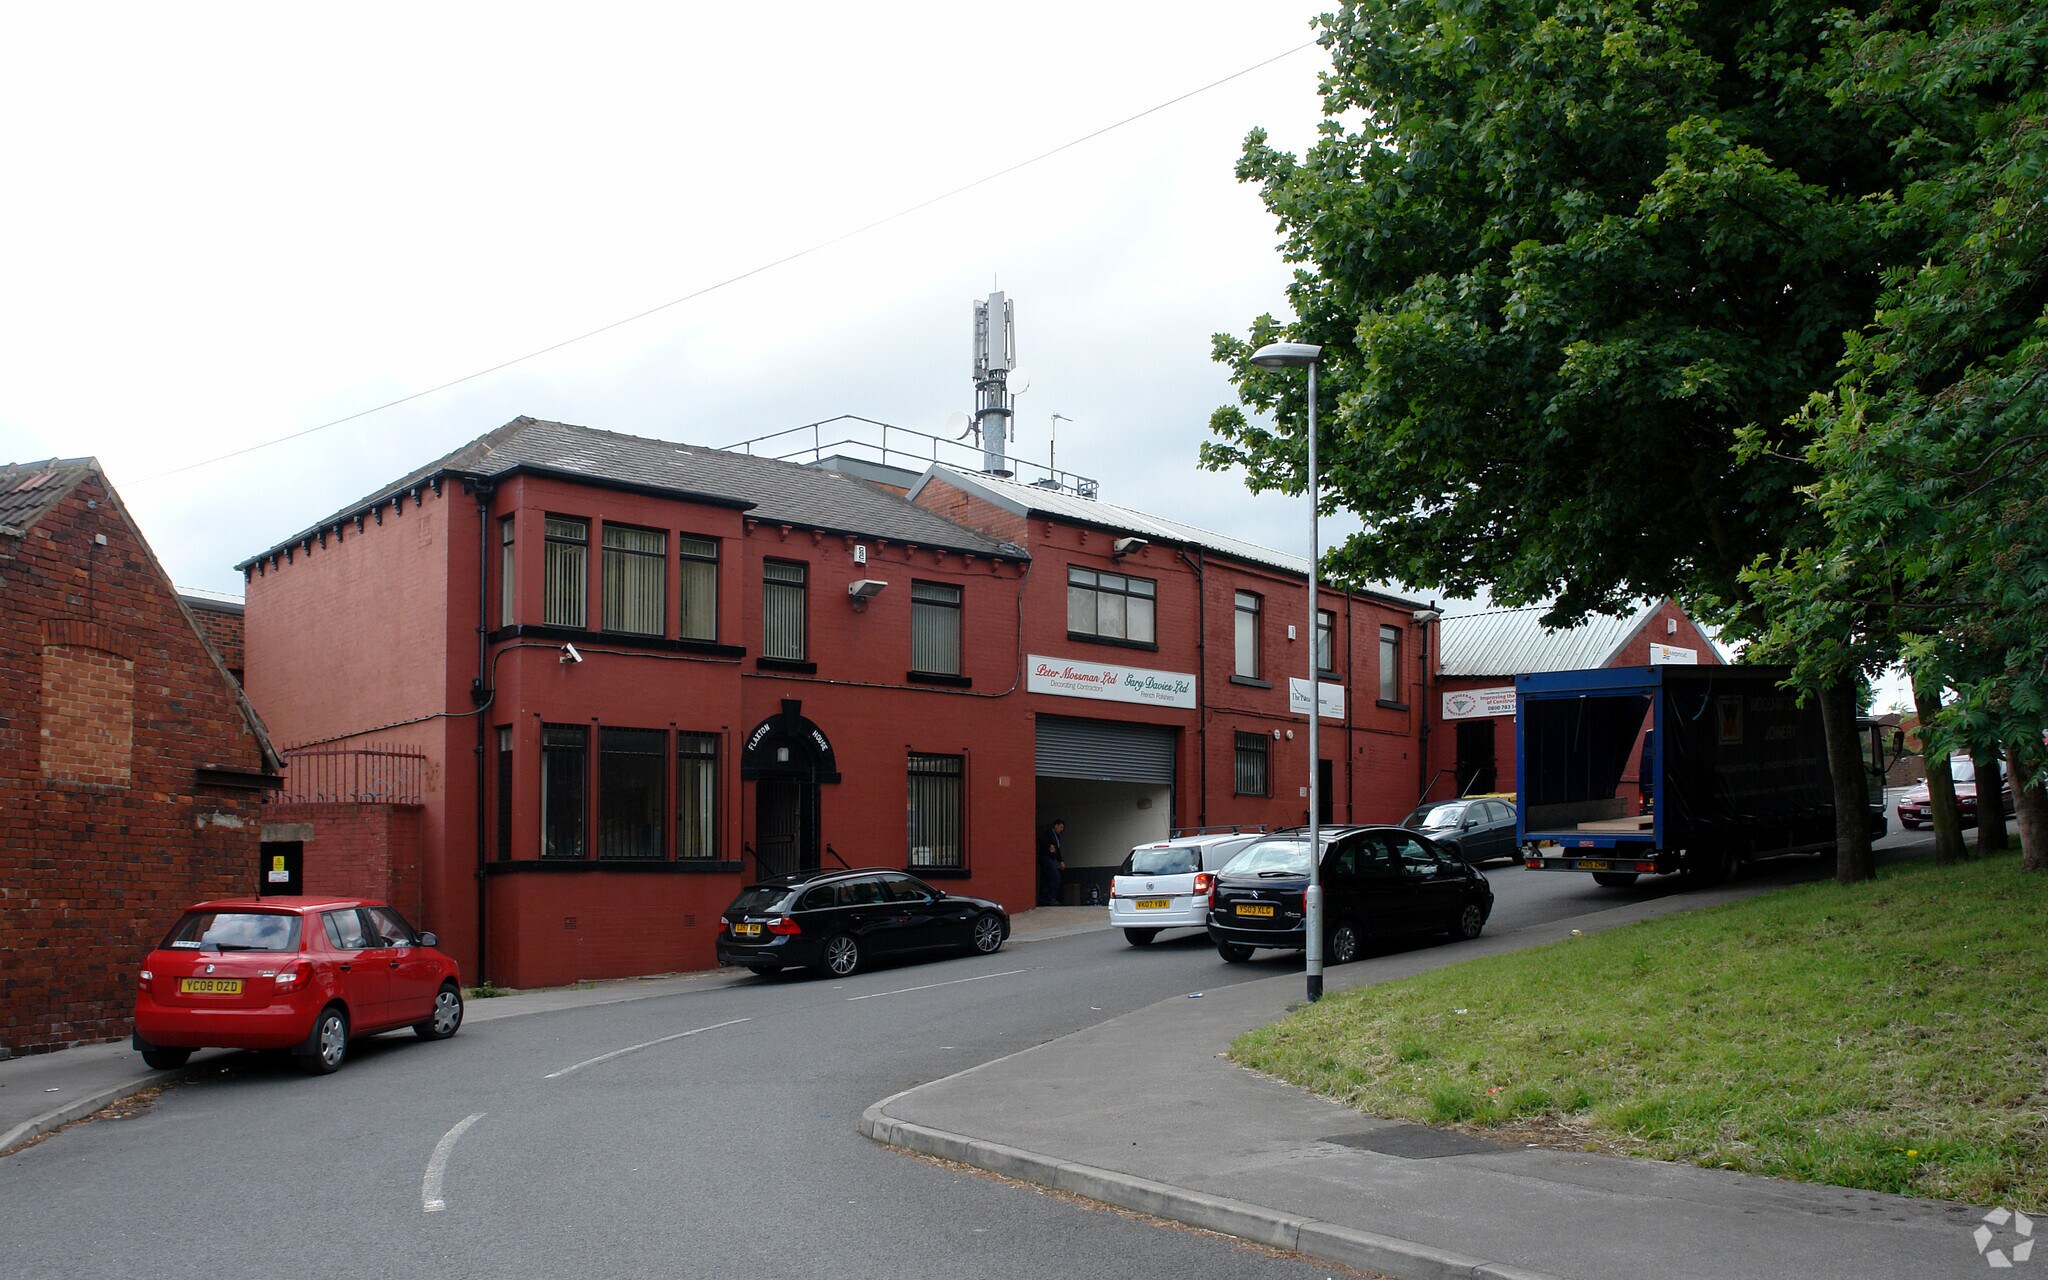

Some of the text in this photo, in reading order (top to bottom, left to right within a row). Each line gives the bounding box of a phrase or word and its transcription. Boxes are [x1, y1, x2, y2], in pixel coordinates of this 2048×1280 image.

[1035, 663, 1118, 685] Peter Mossman Ltd
[1050, 679, 1104, 692] Decorating Contractors
[1124, 673, 1190, 694] Gary Davies Ltd
[1140, 690, 1175, 701] French Polishers
[1292, 693, 1300, 701] The
[748, 723, 829, 751] FLAXTON HOUSE
[1240, 905, 1256, 914] YS03
[186, 981, 237, 992] YC08 OZD
